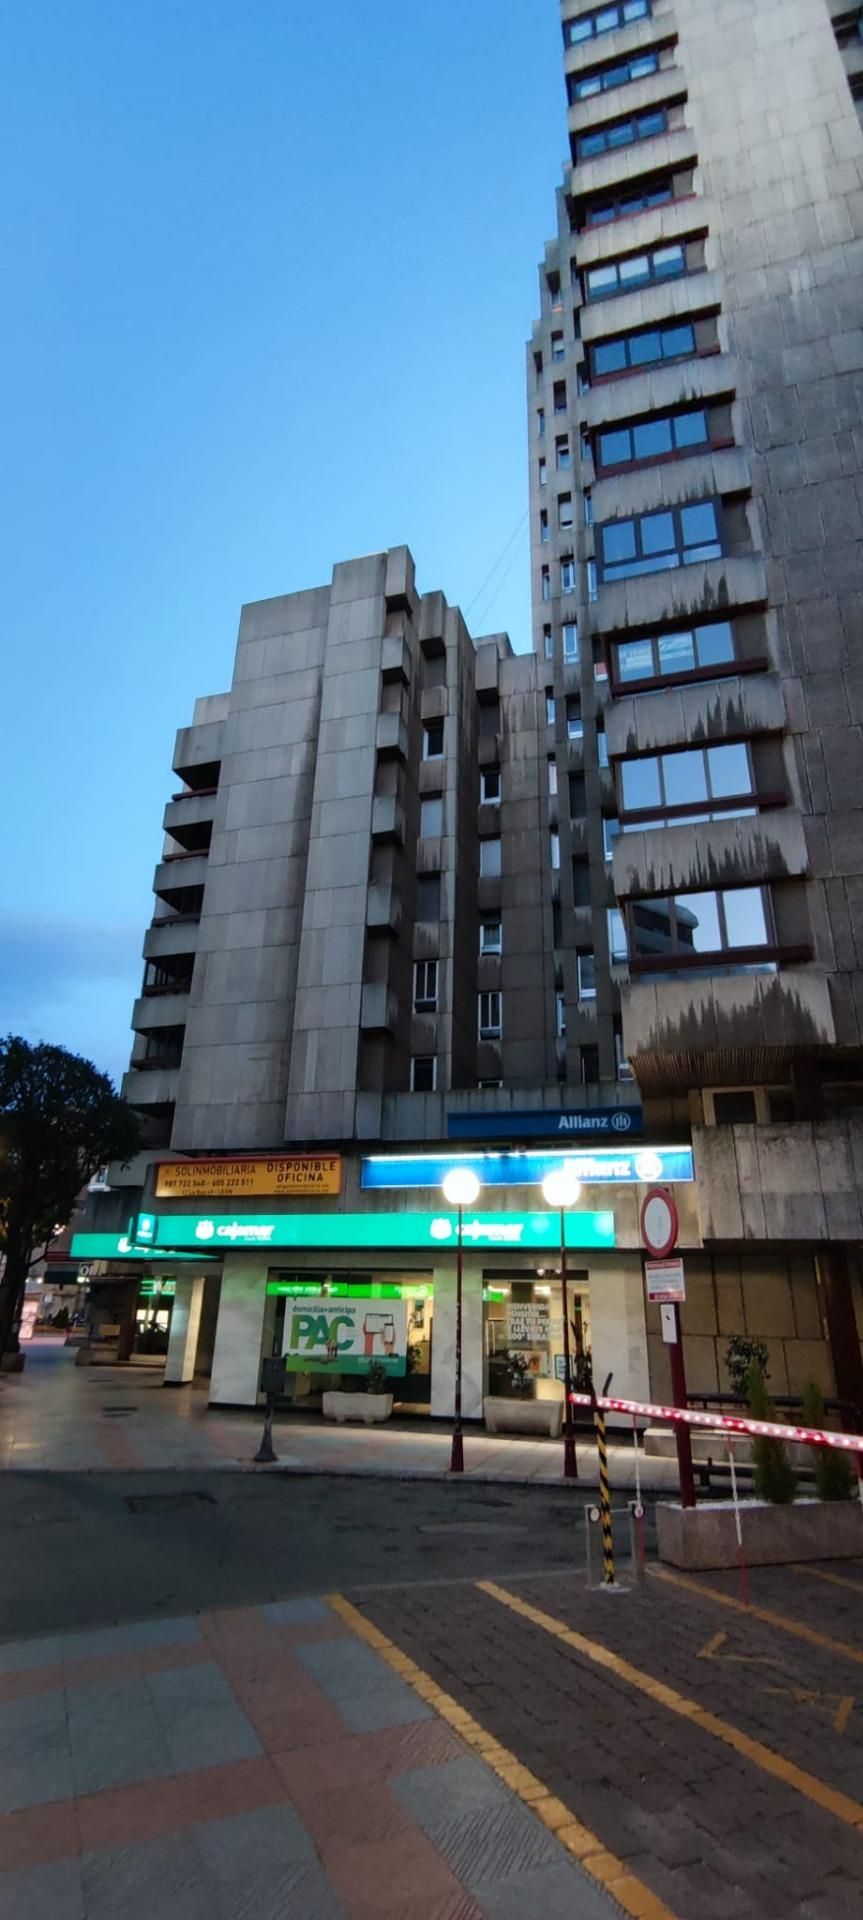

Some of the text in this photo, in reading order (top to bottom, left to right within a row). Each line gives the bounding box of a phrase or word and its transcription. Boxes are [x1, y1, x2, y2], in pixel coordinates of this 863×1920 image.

[558, 1115, 609, 1129] Allianz
[175, 1164, 256, 1177] SOLINMOBILIARIA
[266, 1161, 337, 1173] DISPONIBLE
[179, 1179, 191, 1188] 722
[226, 1178, 239, 1188] 222
[276, 1172, 324, 1183] OFICINA
[289, 1314, 356, 1351] PAC
